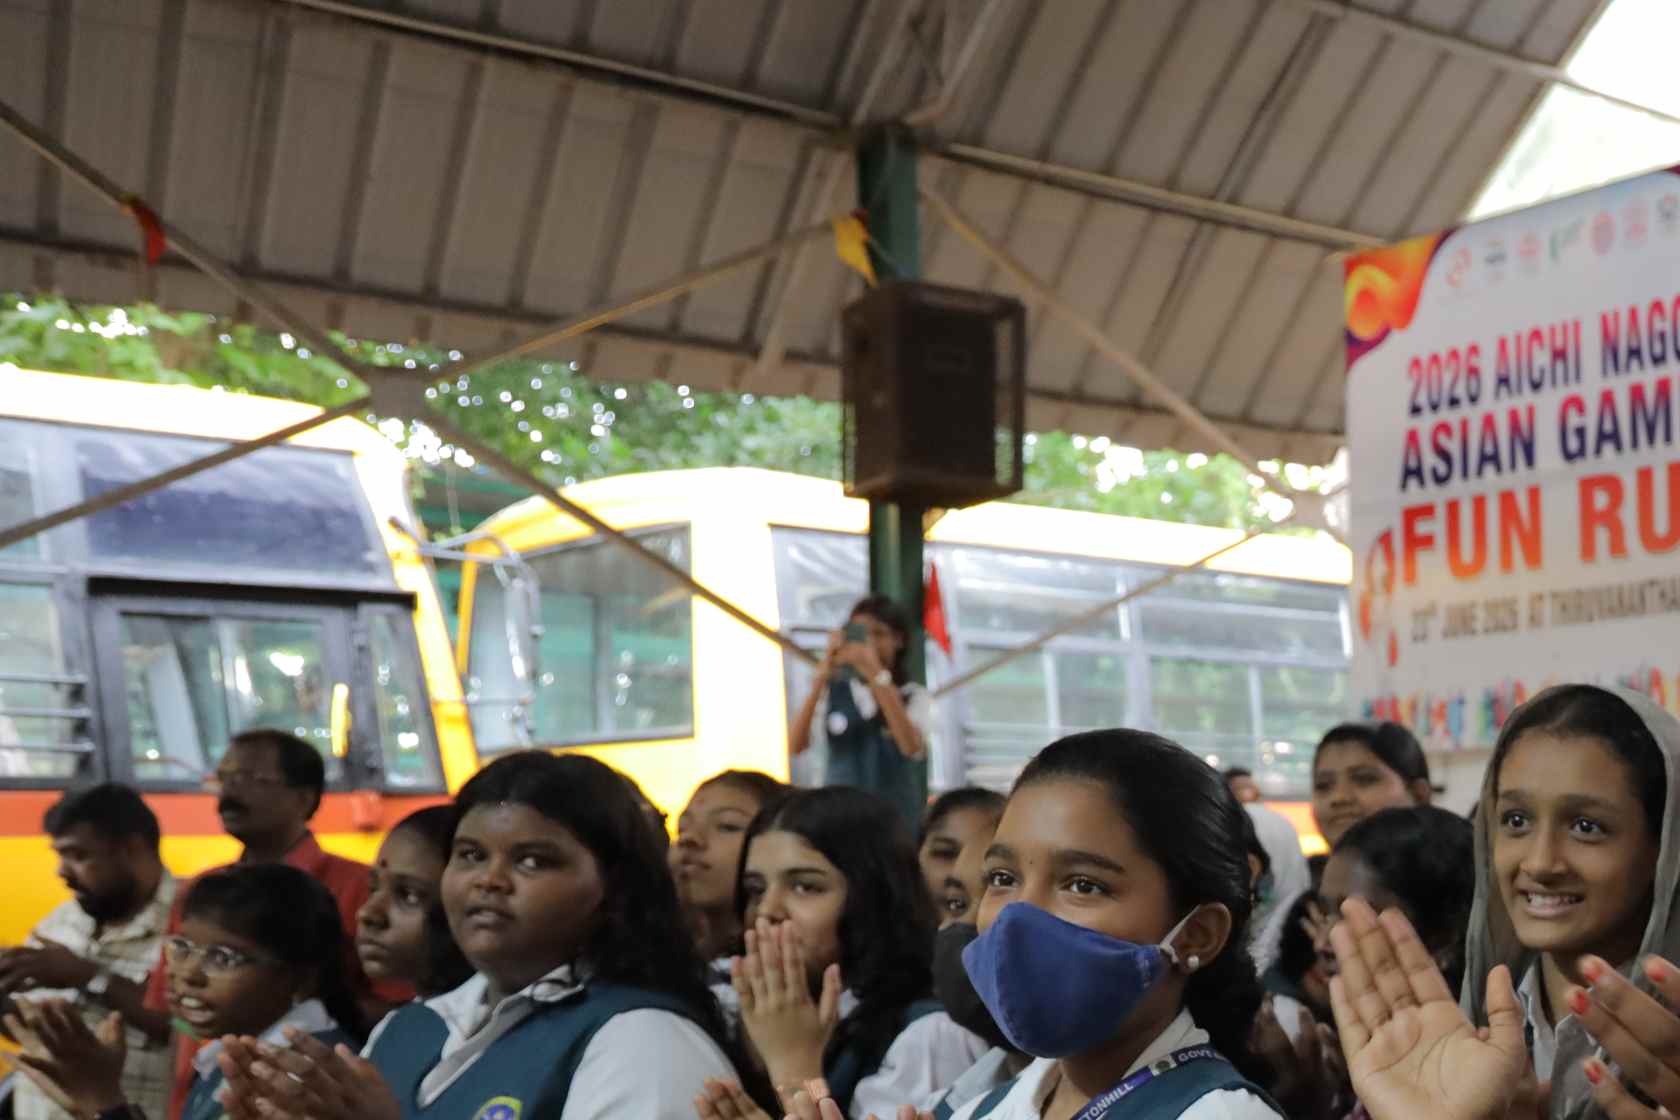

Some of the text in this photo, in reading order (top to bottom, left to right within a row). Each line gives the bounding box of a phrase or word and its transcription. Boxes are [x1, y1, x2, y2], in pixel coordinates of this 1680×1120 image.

[1407, 341, 1482, 418] 2026
[1494, 317, 1583, 402] AICHI
[1400, 400, 1536, 493] ASIAN
[1402, 483, 1543, 588] FUN
